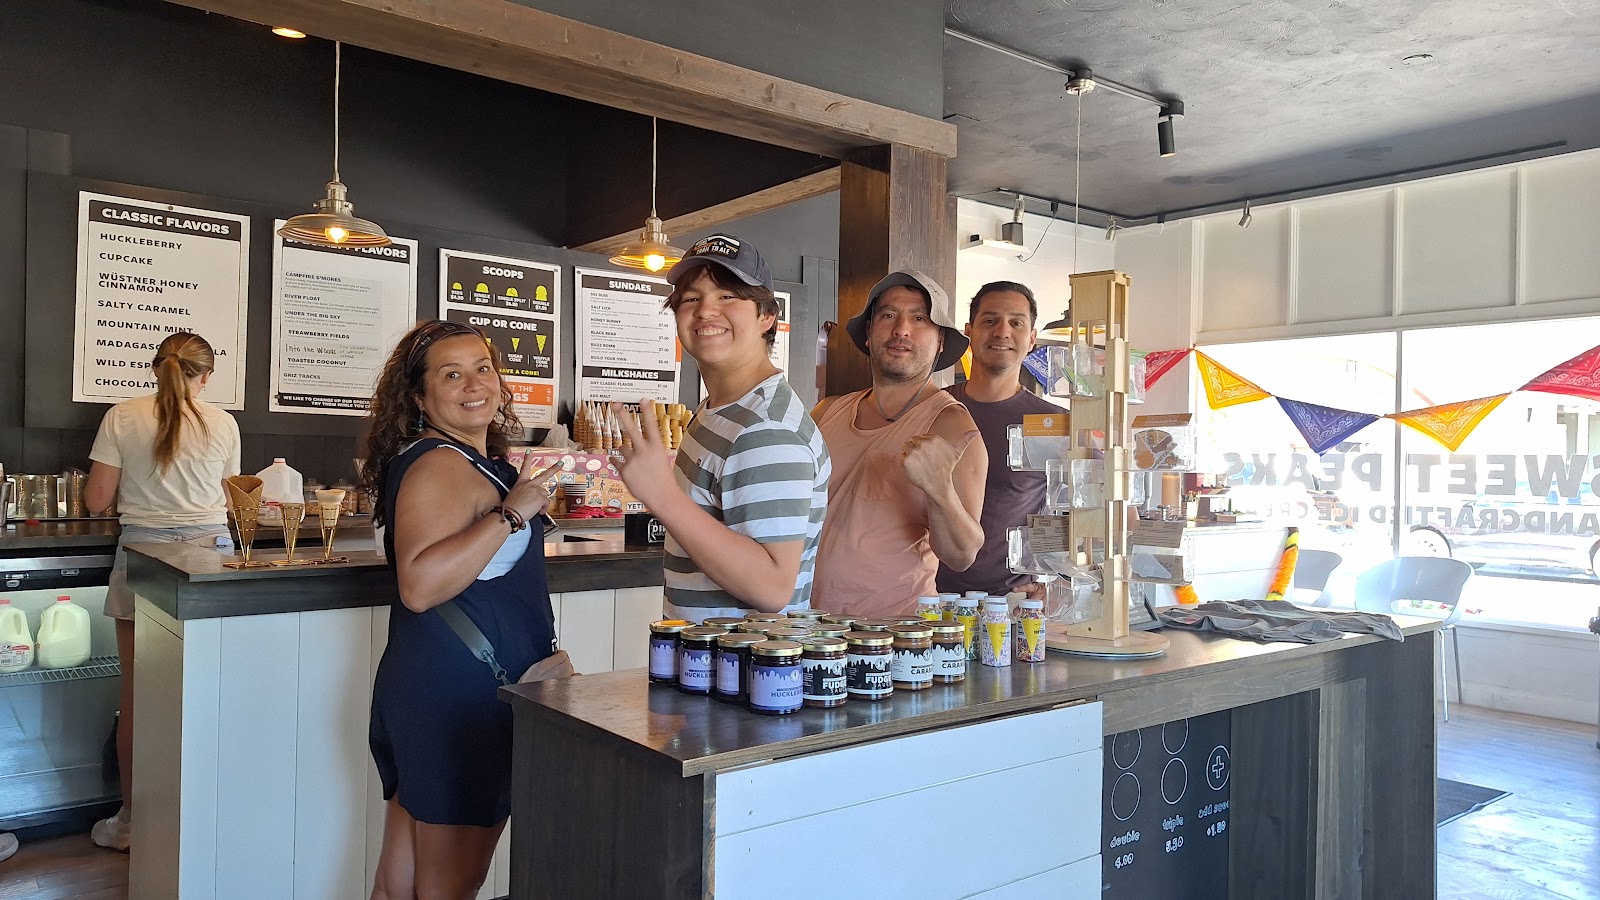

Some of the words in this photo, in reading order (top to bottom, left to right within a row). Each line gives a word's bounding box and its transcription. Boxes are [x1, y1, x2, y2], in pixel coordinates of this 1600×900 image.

[101, 207, 164, 226] CLASSIC
[166, 217, 231, 235] FLAVORS
[100, 233, 182, 250] HUCKLEBERRY
[719, 246, 731, 255] ALE
[99, 252, 154, 265] CUPCAKE
[285, 272, 315, 280] CAMPFIRE
[315, 275, 342, 283] S'MORES
[482, 266, 524, 280] SCOOPS
[98, 281, 164, 294] CINNAMON
[99, 272, 156, 286] WÜSTNER
[160, 279, 199, 290] HONEY
[608, 280, 652, 292] SUNDAES
[98, 300, 134, 310] SALTY
[137, 304, 192, 316] CARAMEL
[97, 320, 161, 332] MOUNTAIN
[468, 316, 490, 326] CUP
[492, 318, 508, 328] OR
[509, 321, 538, 331] CONE
[288, 329, 328, 337] STRAWBERRY
[285, 343, 301, 352] Into
[96, 358, 126, 368] WILD
[601, 369, 659, 379] MILKSHAKES
[1161, 814, 1184, 833] triple
[1109, 830, 1141, 849] double
[1114, 853, 1135, 869] 4.00
